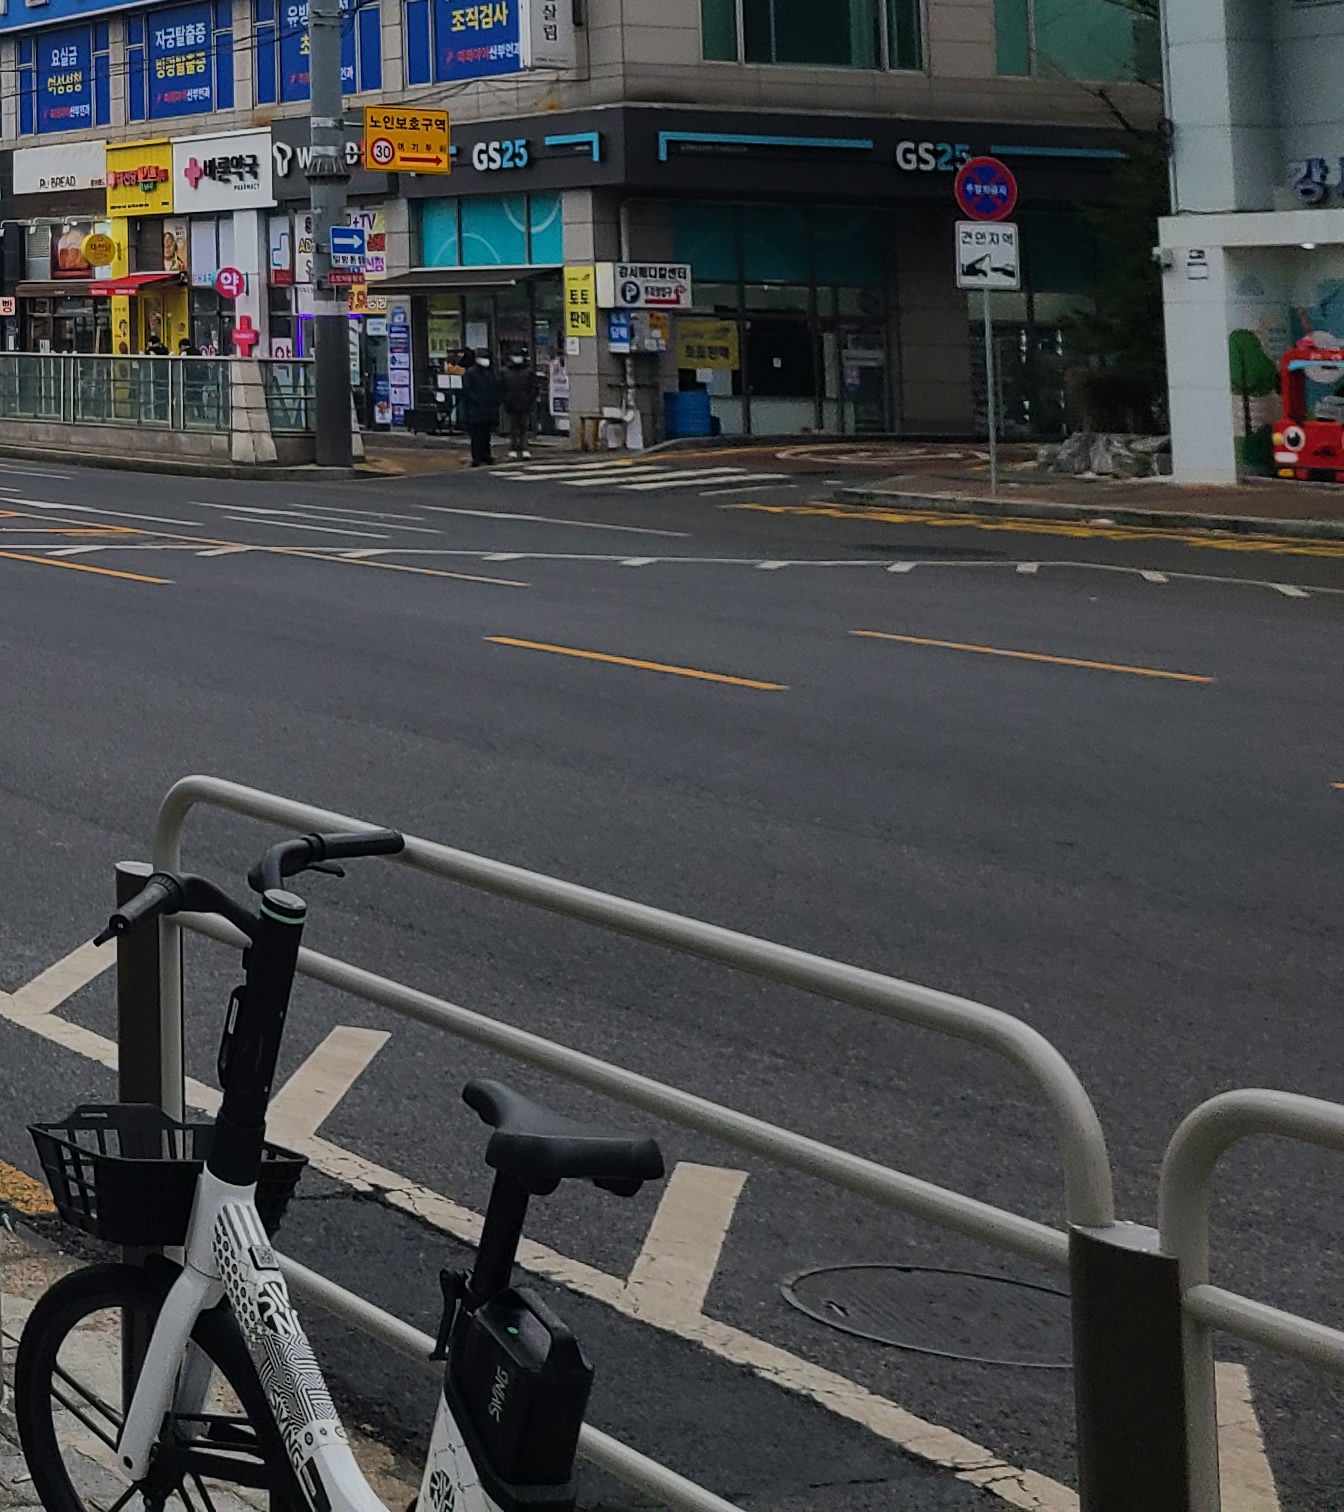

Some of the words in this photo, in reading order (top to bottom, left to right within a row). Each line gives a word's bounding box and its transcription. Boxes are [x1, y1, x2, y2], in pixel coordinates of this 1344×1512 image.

[451, 1, 508, 31] 조직검사
[155, 22, 206, 49] 자궁탈출증
[50, 45, 78, 67] 요실금
[369, 115, 446, 133] 노인보호구역
[376, 145, 391, 159] 30
[472, 138, 529, 172] GS25
[896, 141, 973, 172] GS25
[203, 154, 259, 182] 바른약국
[221, 272, 240, 295] 약
[569, 289, 589, 305] 토토
[488, 1365, 508, 1422] SWING
